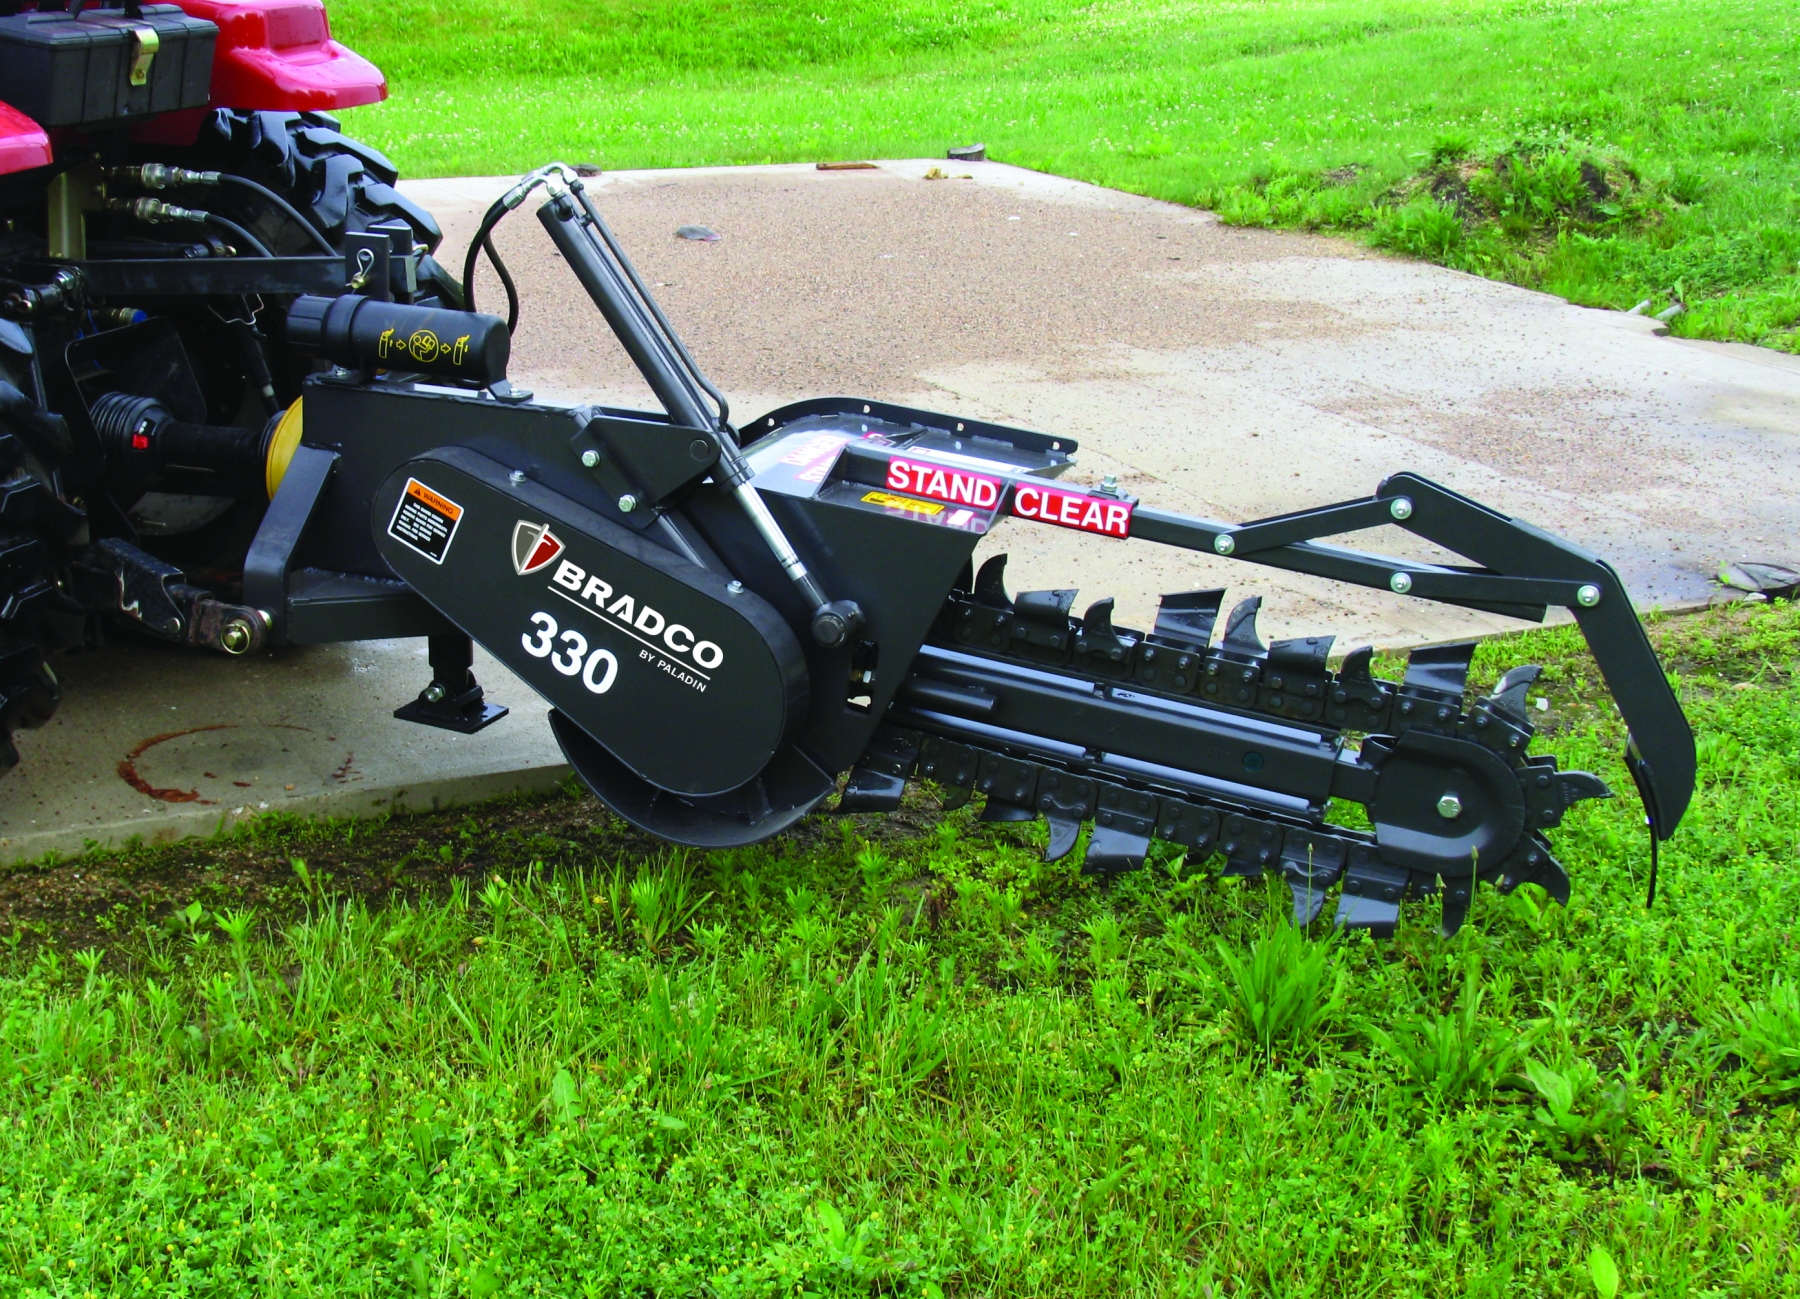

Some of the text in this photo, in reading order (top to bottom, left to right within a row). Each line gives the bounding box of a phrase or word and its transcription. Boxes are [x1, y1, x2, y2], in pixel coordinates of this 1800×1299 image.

[423, 492, 454, 515] WARNING
[887, 461, 997, 507] STAND
[1015, 488, 1129, 533] CLEAR
[552, 559, 724, 669] BRADCO
[521, 611, 618, 694] 330
[639, 649, 707, 693] BY PALADIN
